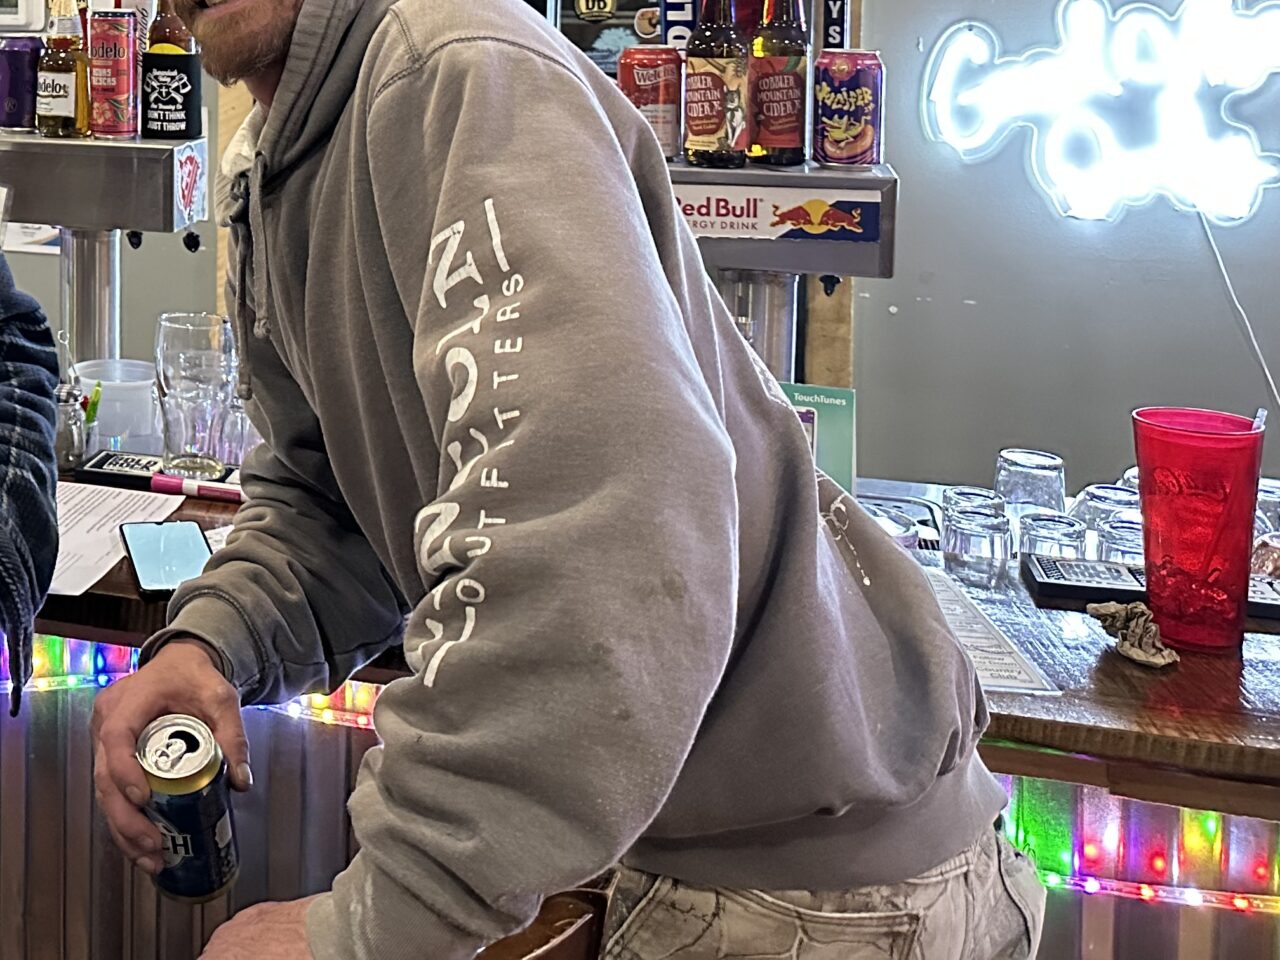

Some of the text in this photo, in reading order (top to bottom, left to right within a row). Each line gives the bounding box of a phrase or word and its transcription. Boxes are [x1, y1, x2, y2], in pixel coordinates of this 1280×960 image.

[759, 75, 795, 90] COBBLER
[757, 88, 801, 102] MOUNTAIN
[687, 102, 712, 117] CIDER
[764, 101, 792, 116] CIDER
[163, 122, 186, 131] THROW
[715, 198, 757, 218] Bull
[721, 222, 758, 230] DRINK
[793, 392, 846, 406] TouchTunes
[455, 272, 524, 604] OUTFITTERS
